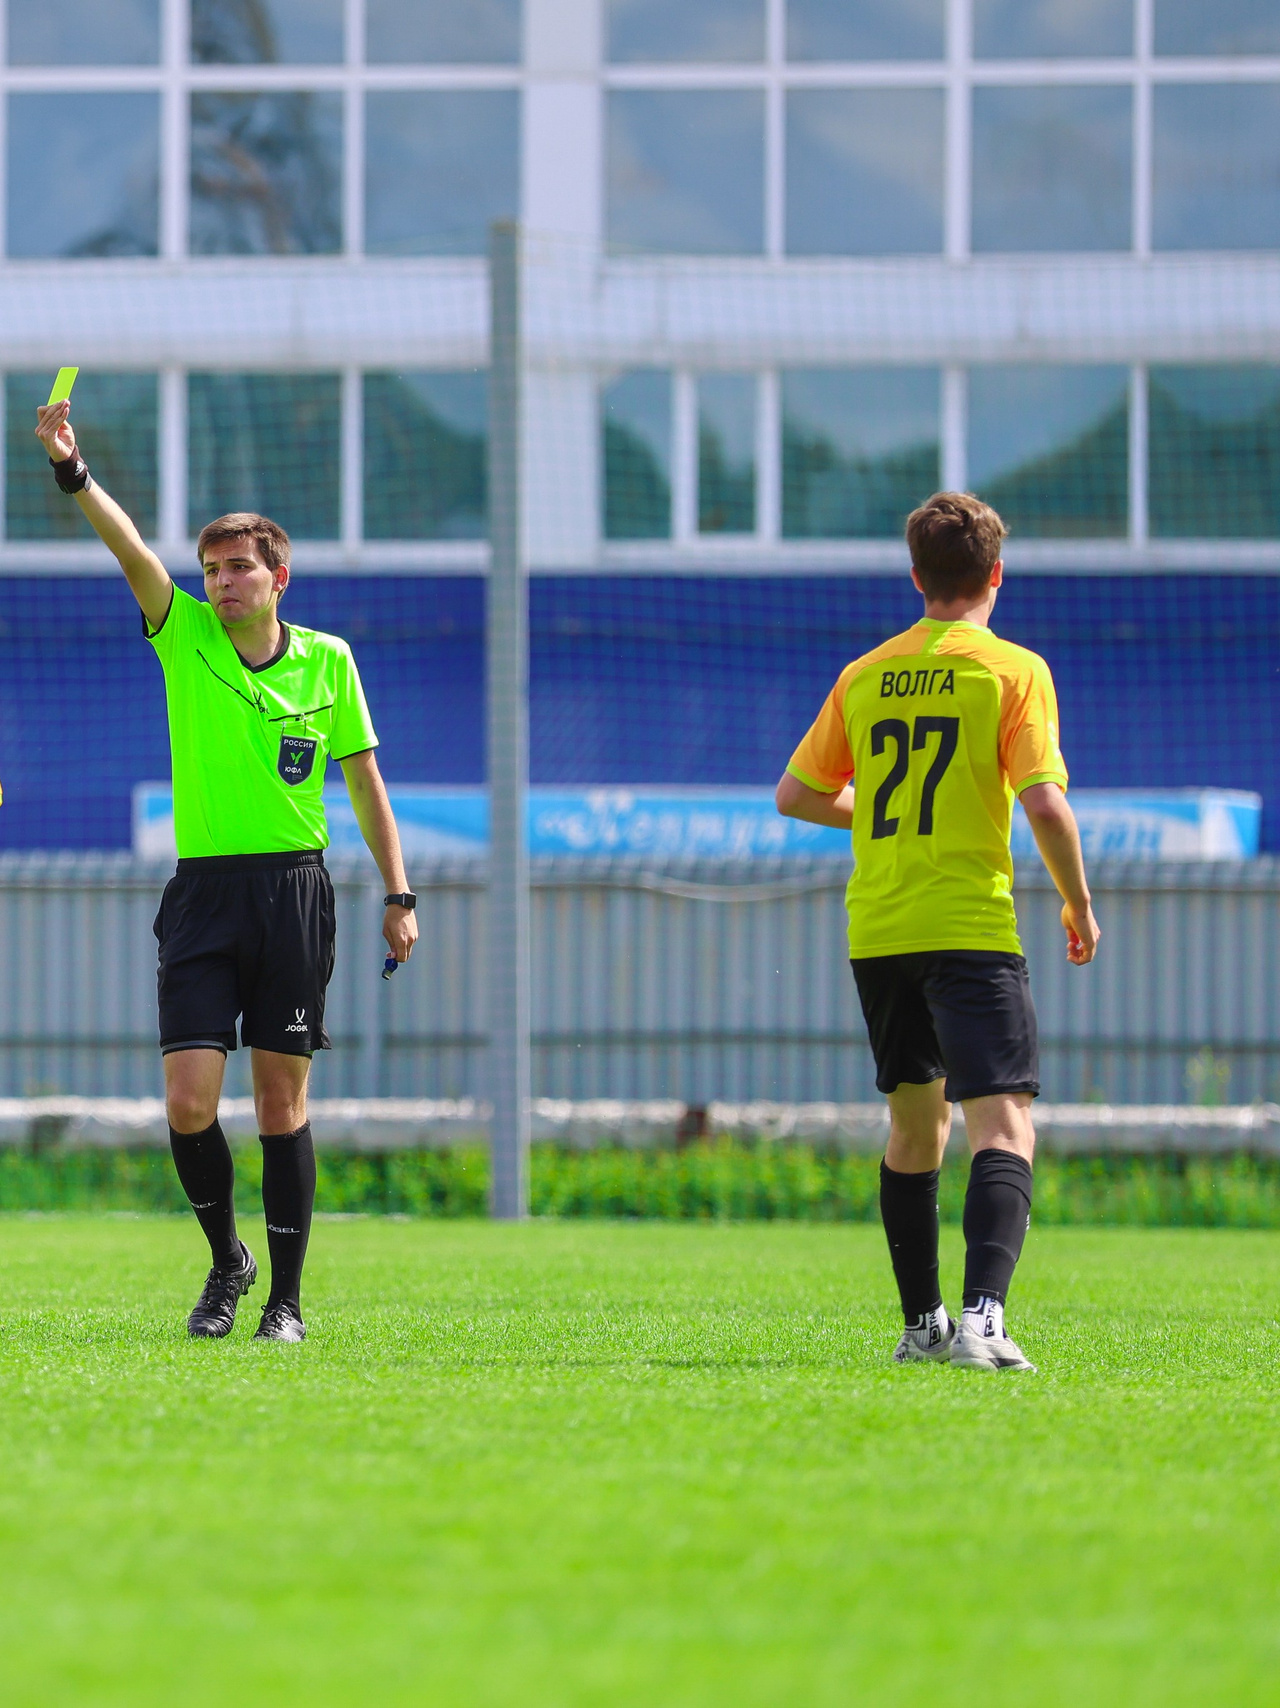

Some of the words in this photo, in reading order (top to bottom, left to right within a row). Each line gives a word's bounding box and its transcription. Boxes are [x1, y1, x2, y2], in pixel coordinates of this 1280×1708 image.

[880, 669, 954, 698] ВОЛГА
[283, 738, 314, 749] РОССИЯ
[284, 766, 302, 774] ЮФЛ
[871, 715, 960, 840] 27
[284, 1024, 309, 1032] JOGEL
